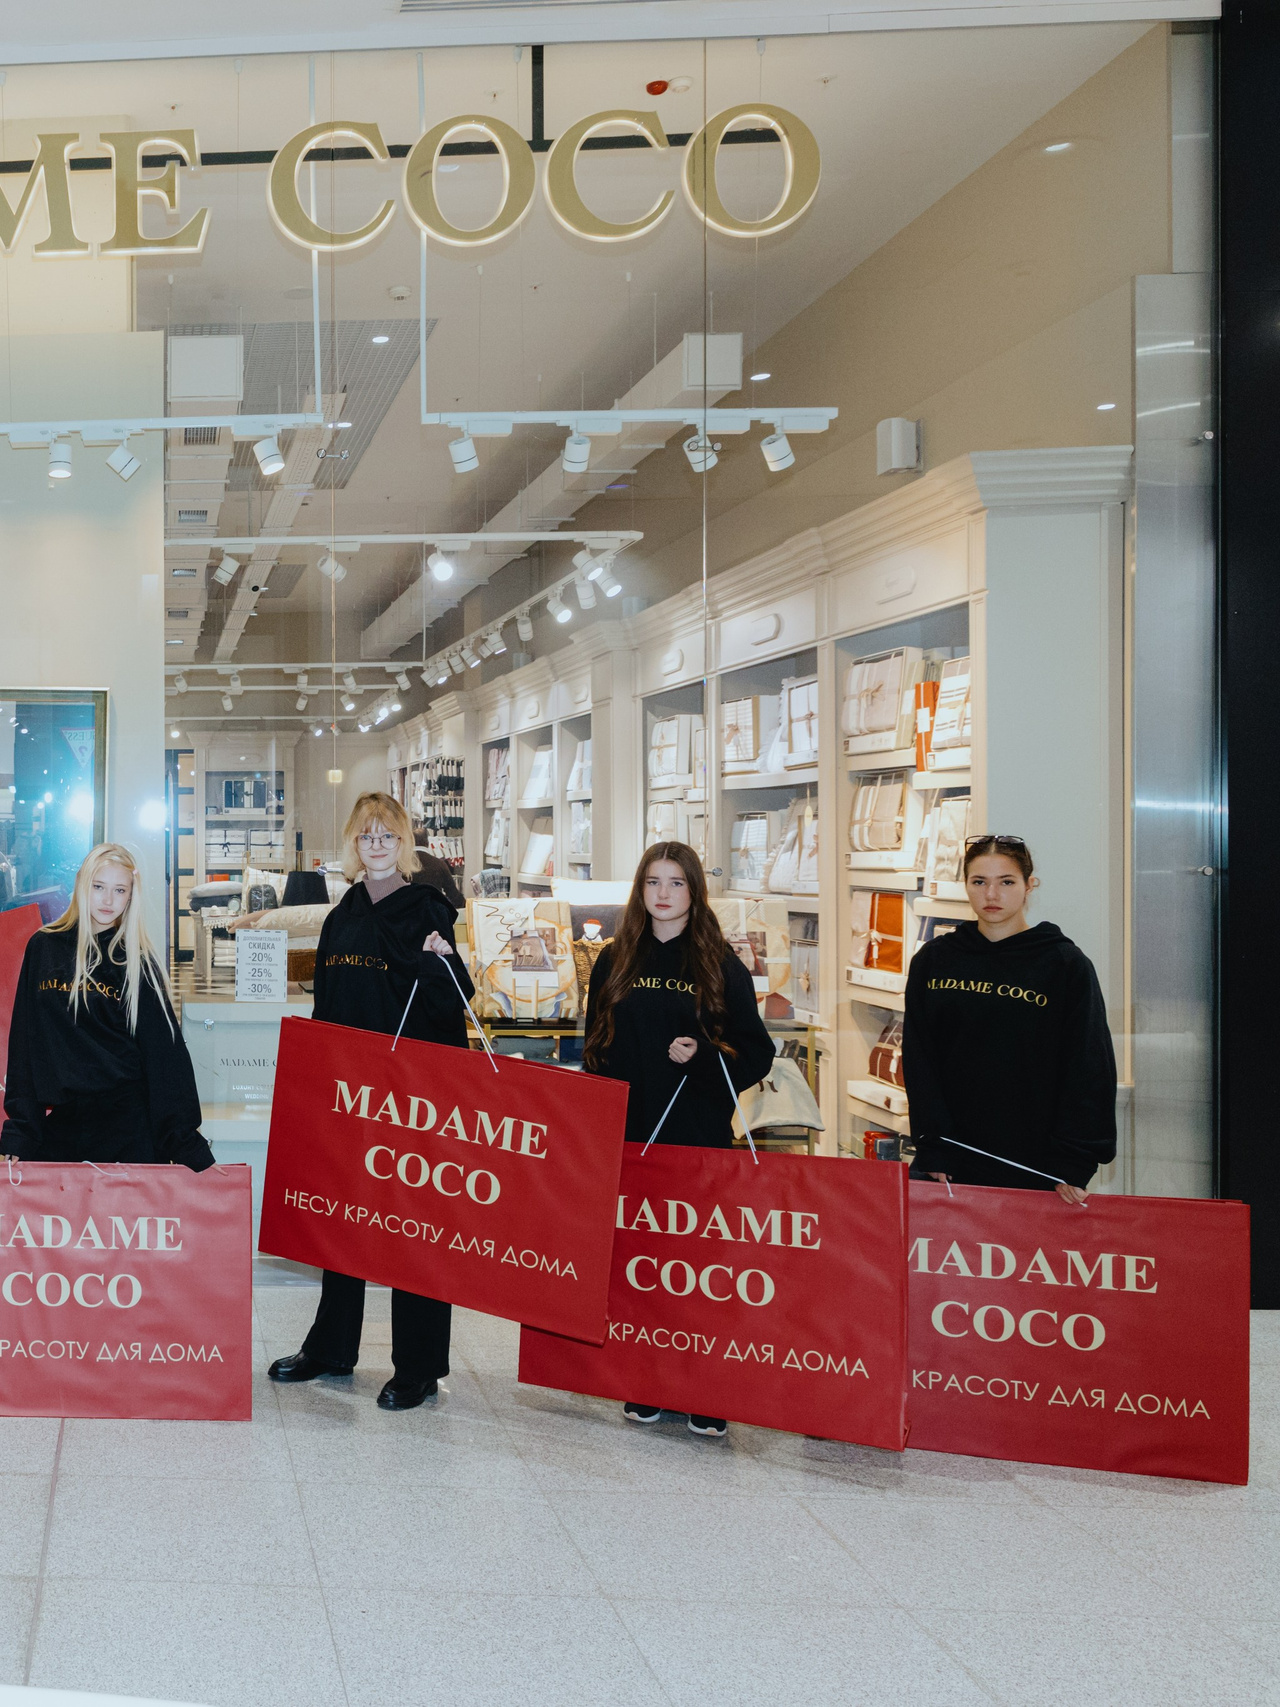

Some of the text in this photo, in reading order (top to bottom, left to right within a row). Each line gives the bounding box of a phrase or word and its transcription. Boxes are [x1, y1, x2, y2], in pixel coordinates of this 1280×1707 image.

[267, 103, 821, 252] COCO
[248, 942, 276, 951] СКИДКА
[248, 952, 273, 962] -20%
[247, 983, 272, 994] -30%
[248, 967, 273, 978] -25%
[665, 978, 698, 995] COC
[996, 984, 1048, 1007] COCO
[220, 1058, 270, 1067] MADAME
[331, 1079, 548, 1159] MADAME
[364, 1145, 501, 1205] COCO
[284, 1188, 578, 1281] НЕСУ КРАСОТУ ДЛЯ ДОМА
[615, 1195, 821, 1250] ADAME
[2, 1271, 142, 1308] COCO
[625, 1255, 775, 1307] COCO
[931, 1300, 1106, 1351] COCO
[96, 1341, 142, 1362] ДЛЯ
[149, 1343, 224, 1363] ДОМА
[608, 1321, 869, 1379] КРАСОТУ ДЛЯ ДОМА
[912, 1369, 1210, 1420] КРАСОТУ ДЛЯ ДОМА
